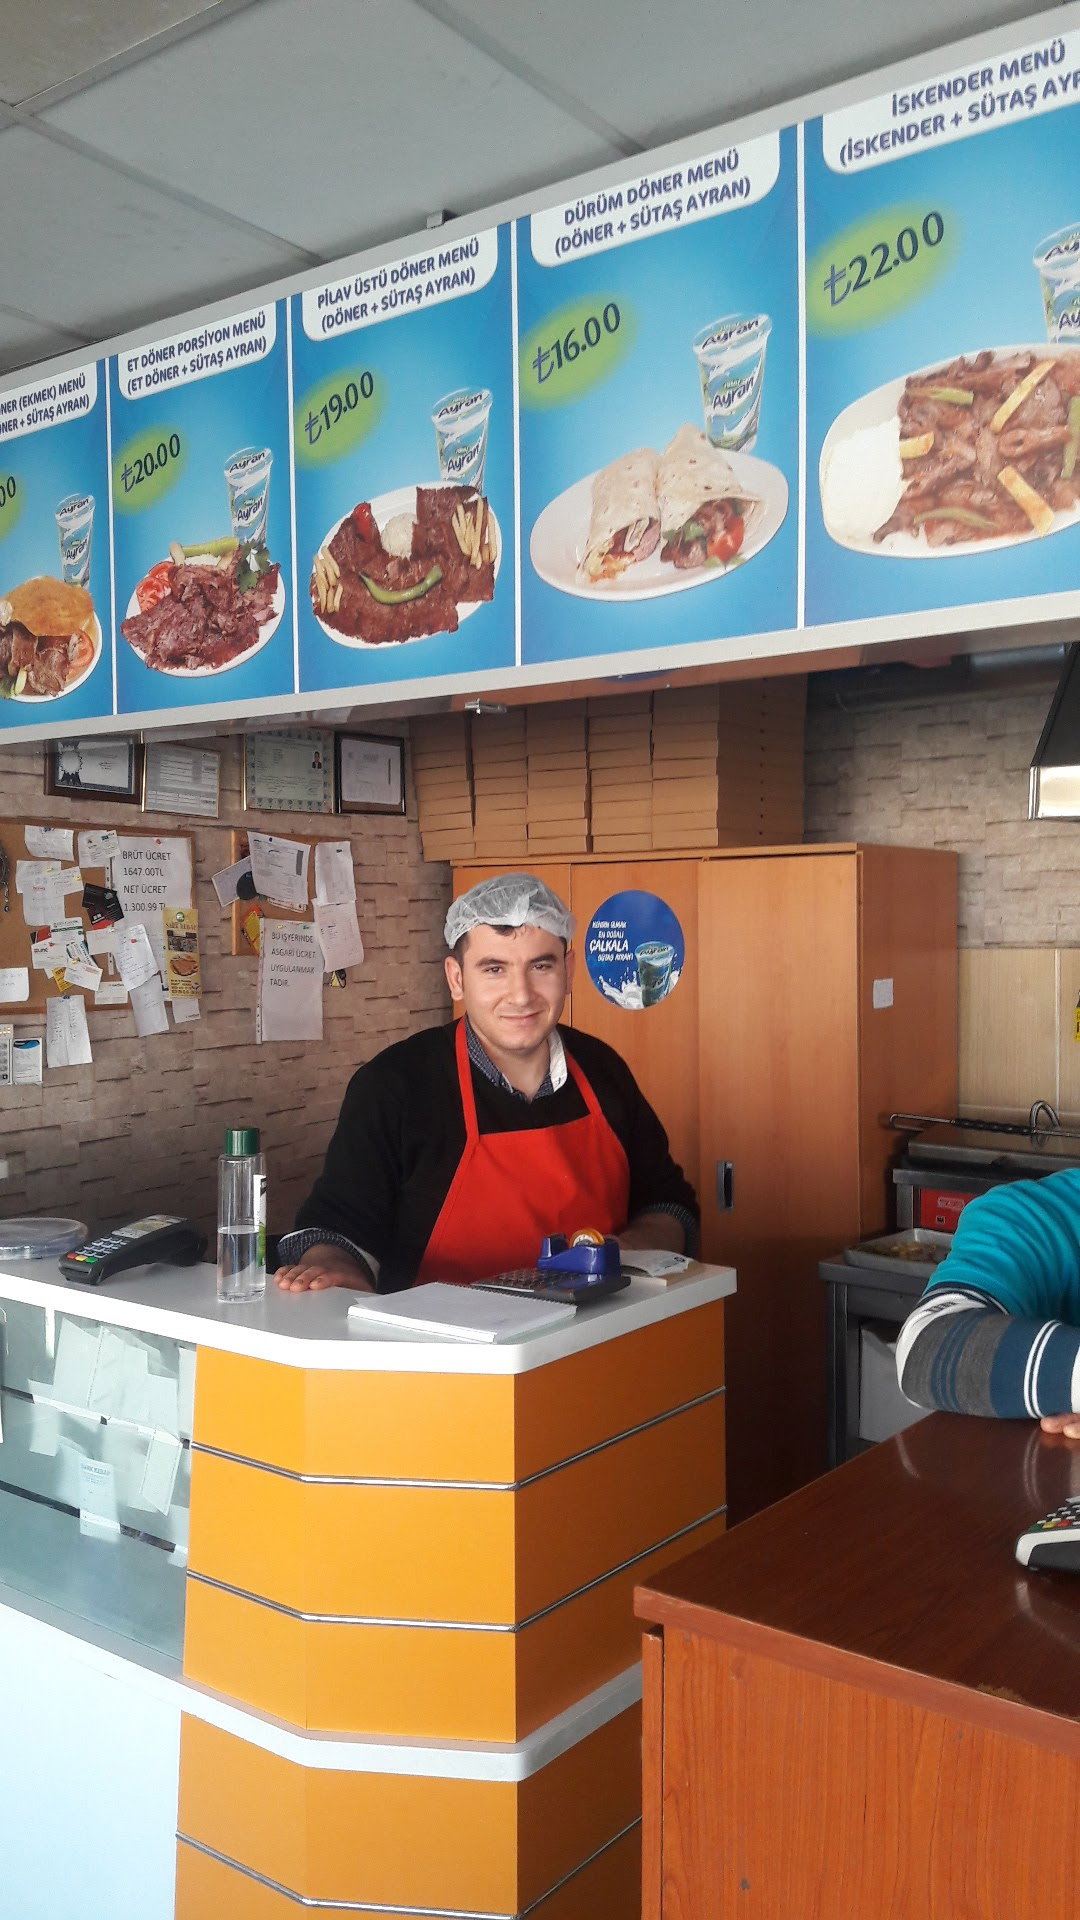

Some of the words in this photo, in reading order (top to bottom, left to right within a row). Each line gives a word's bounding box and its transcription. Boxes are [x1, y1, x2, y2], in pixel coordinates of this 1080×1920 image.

[891, 66, 993, 117] İSKENDER
[999, 38, 1066, 81] MENÜ
[839, 113, 945, 167] (İSKENDER
[950, 112, 962, 127] +
[967, 83, 1038, 122] SÜTAŞ
[564, 193, 623, 226] DÜRÜM
[627, 172, 682, 204] DÖNER
[687, 148, 740, 185] MENÜ
[555, 221, 614, 258] (DÖNER
[617, 221, 627, 234] +
[630, 199, 683, 230] SÜTAŞ
[686, 176, 751, 214] AYRAN)
[317, 284, 352, 309] PİLAV
[354, 270, 387, 297] ÜSTÜ
[390, 256, 435, 284] DÖNER
[438, 237, 479, 268] MENÜ
[321, 302, 368, 333] (DÖNER
[371, 303, 378, 314] +
[381, 286, 423, 311] SÜTAŞ
[425, 266, 476, 299] AYRAN)
[127, 357, 140, 372] ET
[141, 348, 175, 367] DÖNER
[177, 326, 231, 356] PORSİYON
[232, 310, 266, 337] MENÜ
[702, 319, 759, 349] Ayran
[127, 376, 143, 395] (ET
[145, 365, 179, 387] DÖNER
[182, 366, 188, 375] +
[189, 350, 224, 373] SÜTAŞ
[225, 336, 267, 362] AYRAN)
[0, 399, 17, 416] NER
[19, 385, 57, 412] (EKMEK)
[58, 372, 86, 396] MENÜ
[438, 393, 483, 418] Ayran
[713, 376, 754, 410] Ayran
[26, 405, 55, 426] SÜTAŞ
[56, 394, 90, 416] AYRAN)
[229, 452, 265, 473] Ayran
[447, 443, 480, 473] Ayran
[60, 499, 89, 516] Ayran
[237, 497, 263, 521] Ayran
[66, 539, 88, 560] Ayran
[122, 850, 143, 860] BRÜT
[145, 850, 171, 861] ÜCRET
[123, 867, 164, 877] 1647.00TL
[123, 885, 139, 894] NET
[141, 884, 167, 894] ÜCRET
[124, 903, 157, 912] 1.300.99
[271, 932, 280, 940] BU
[589, 939, 629, 954] ÇALKALA
